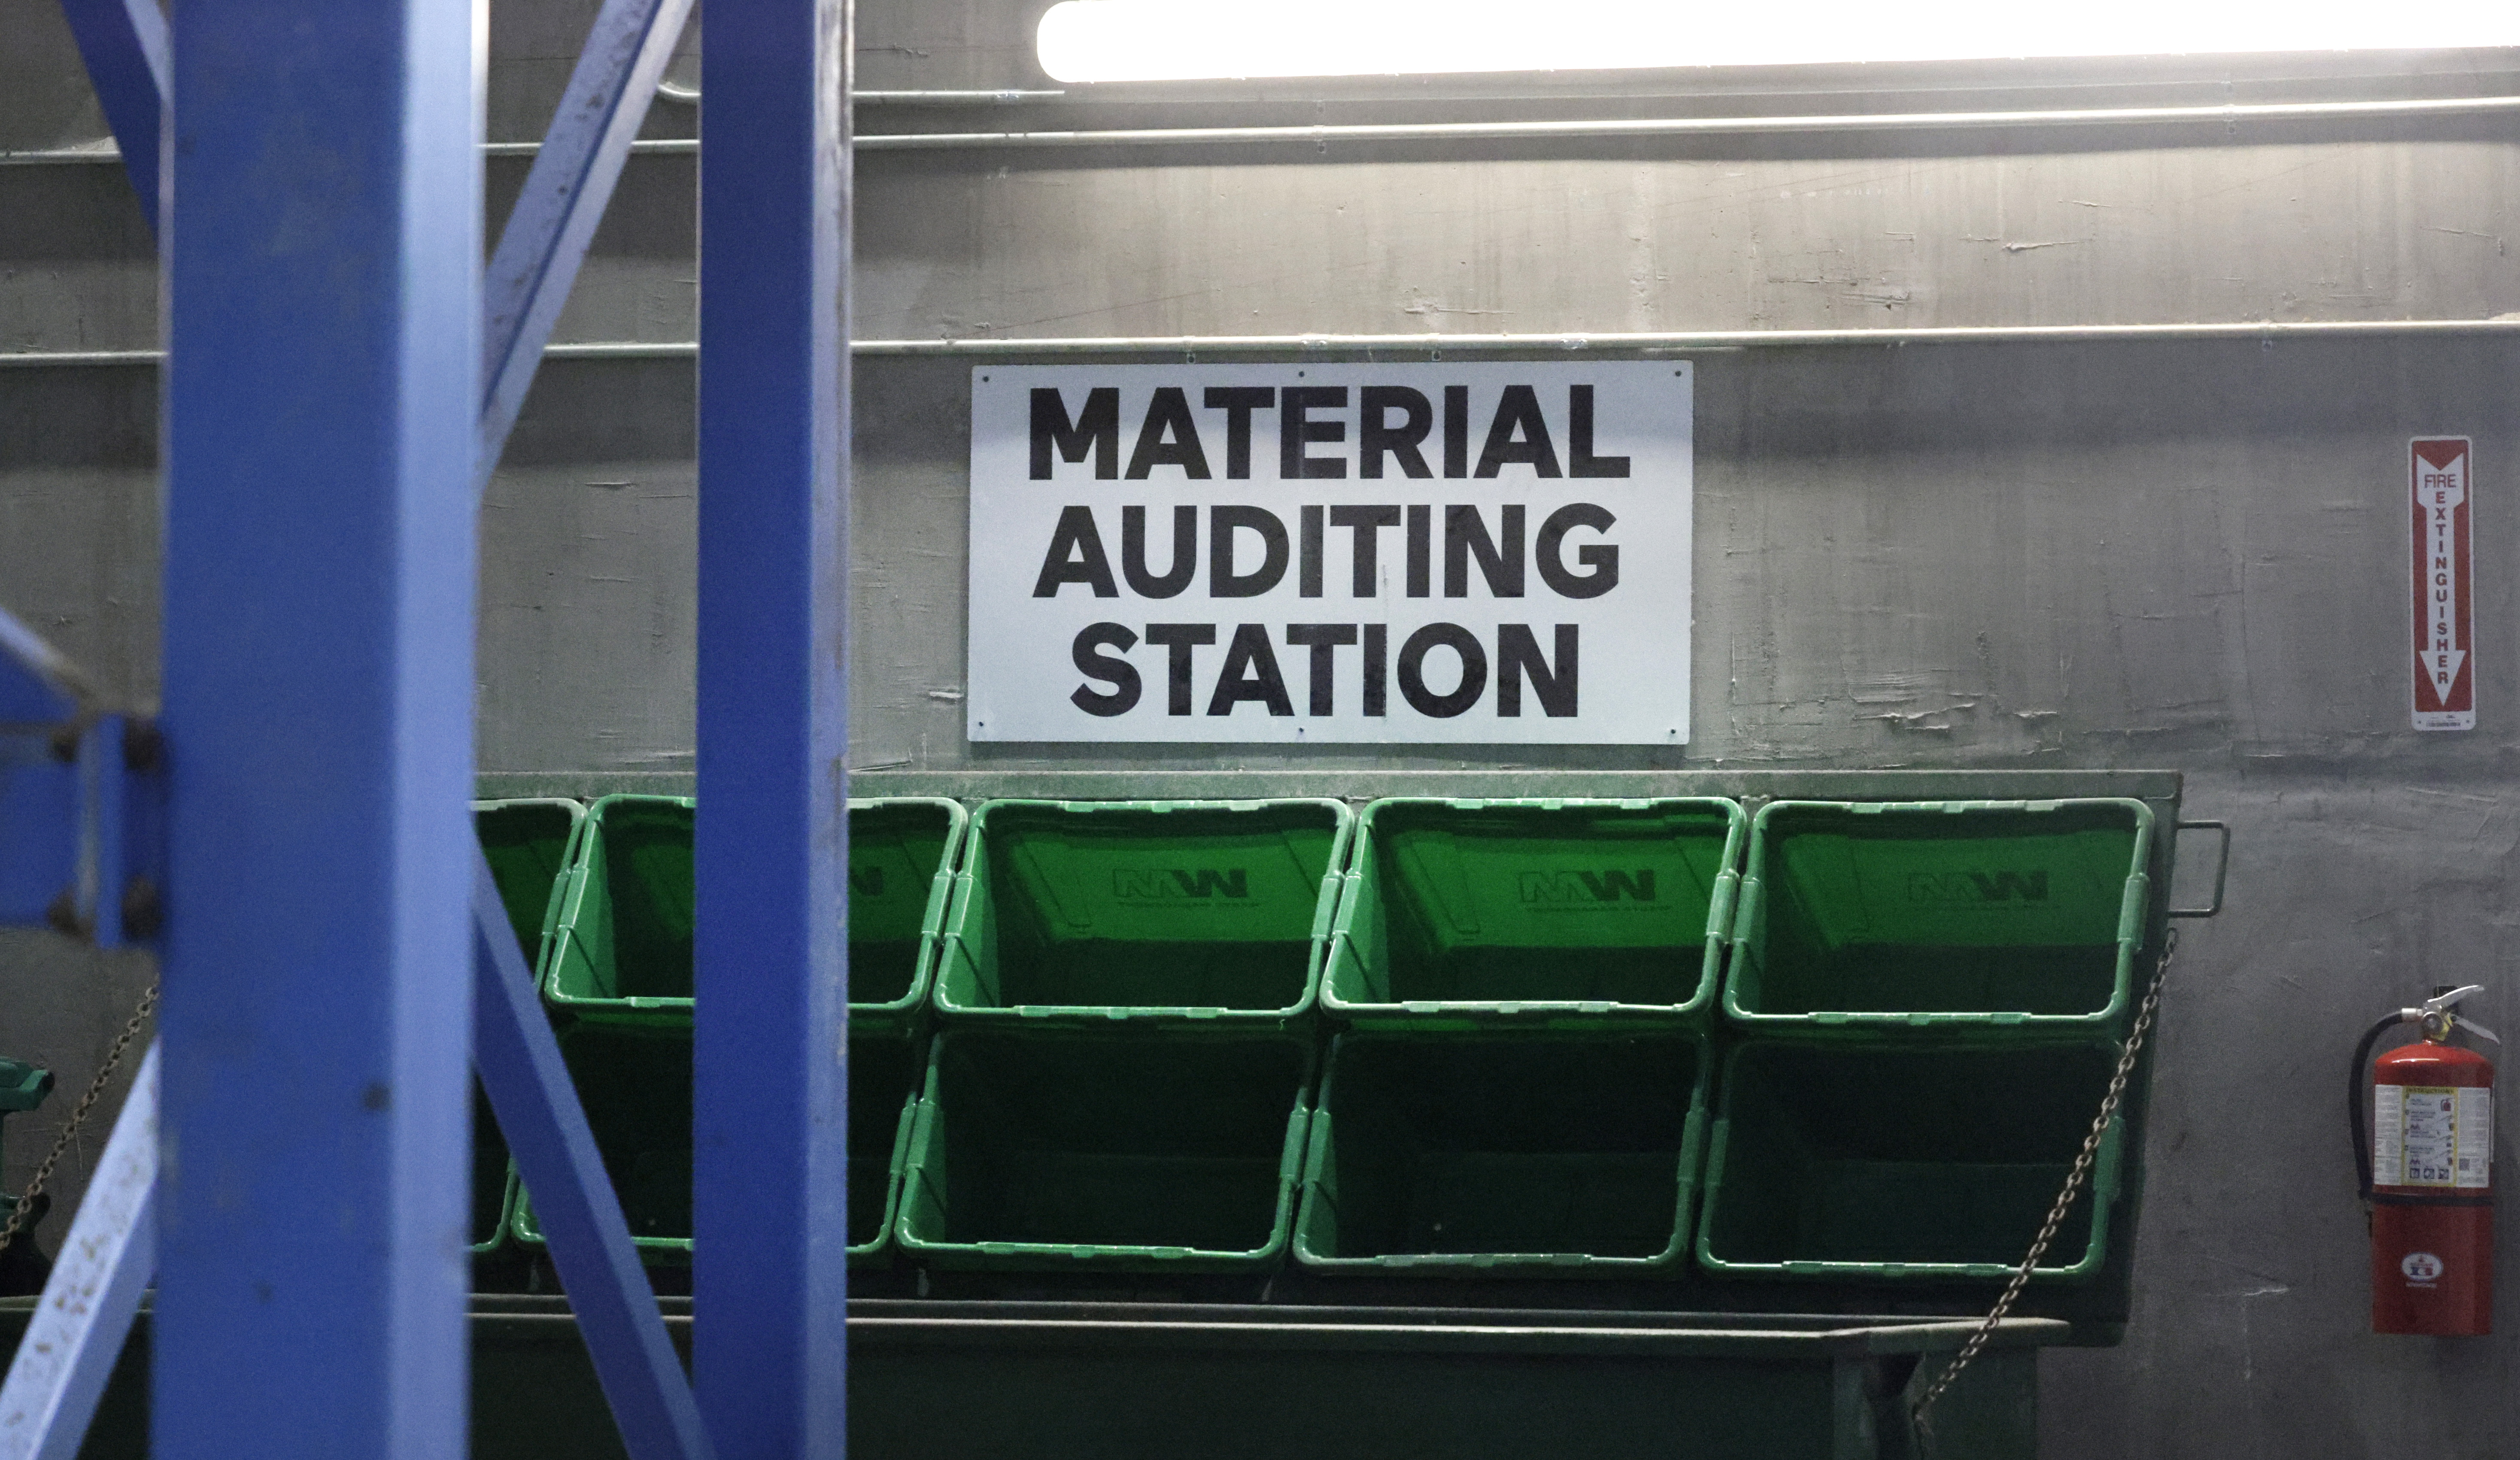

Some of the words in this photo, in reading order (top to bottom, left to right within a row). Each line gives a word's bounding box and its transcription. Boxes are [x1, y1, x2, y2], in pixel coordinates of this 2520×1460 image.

[1029, 385, 1630, 480] MATERIAL
[2424, 474, 2456, 488] FIRE
[1033, 504, 1618, 599] AUDITING
[2435, 491, 2448, 684] EXTINGUISHER
[1070, 622, 1579, 718] STATION
